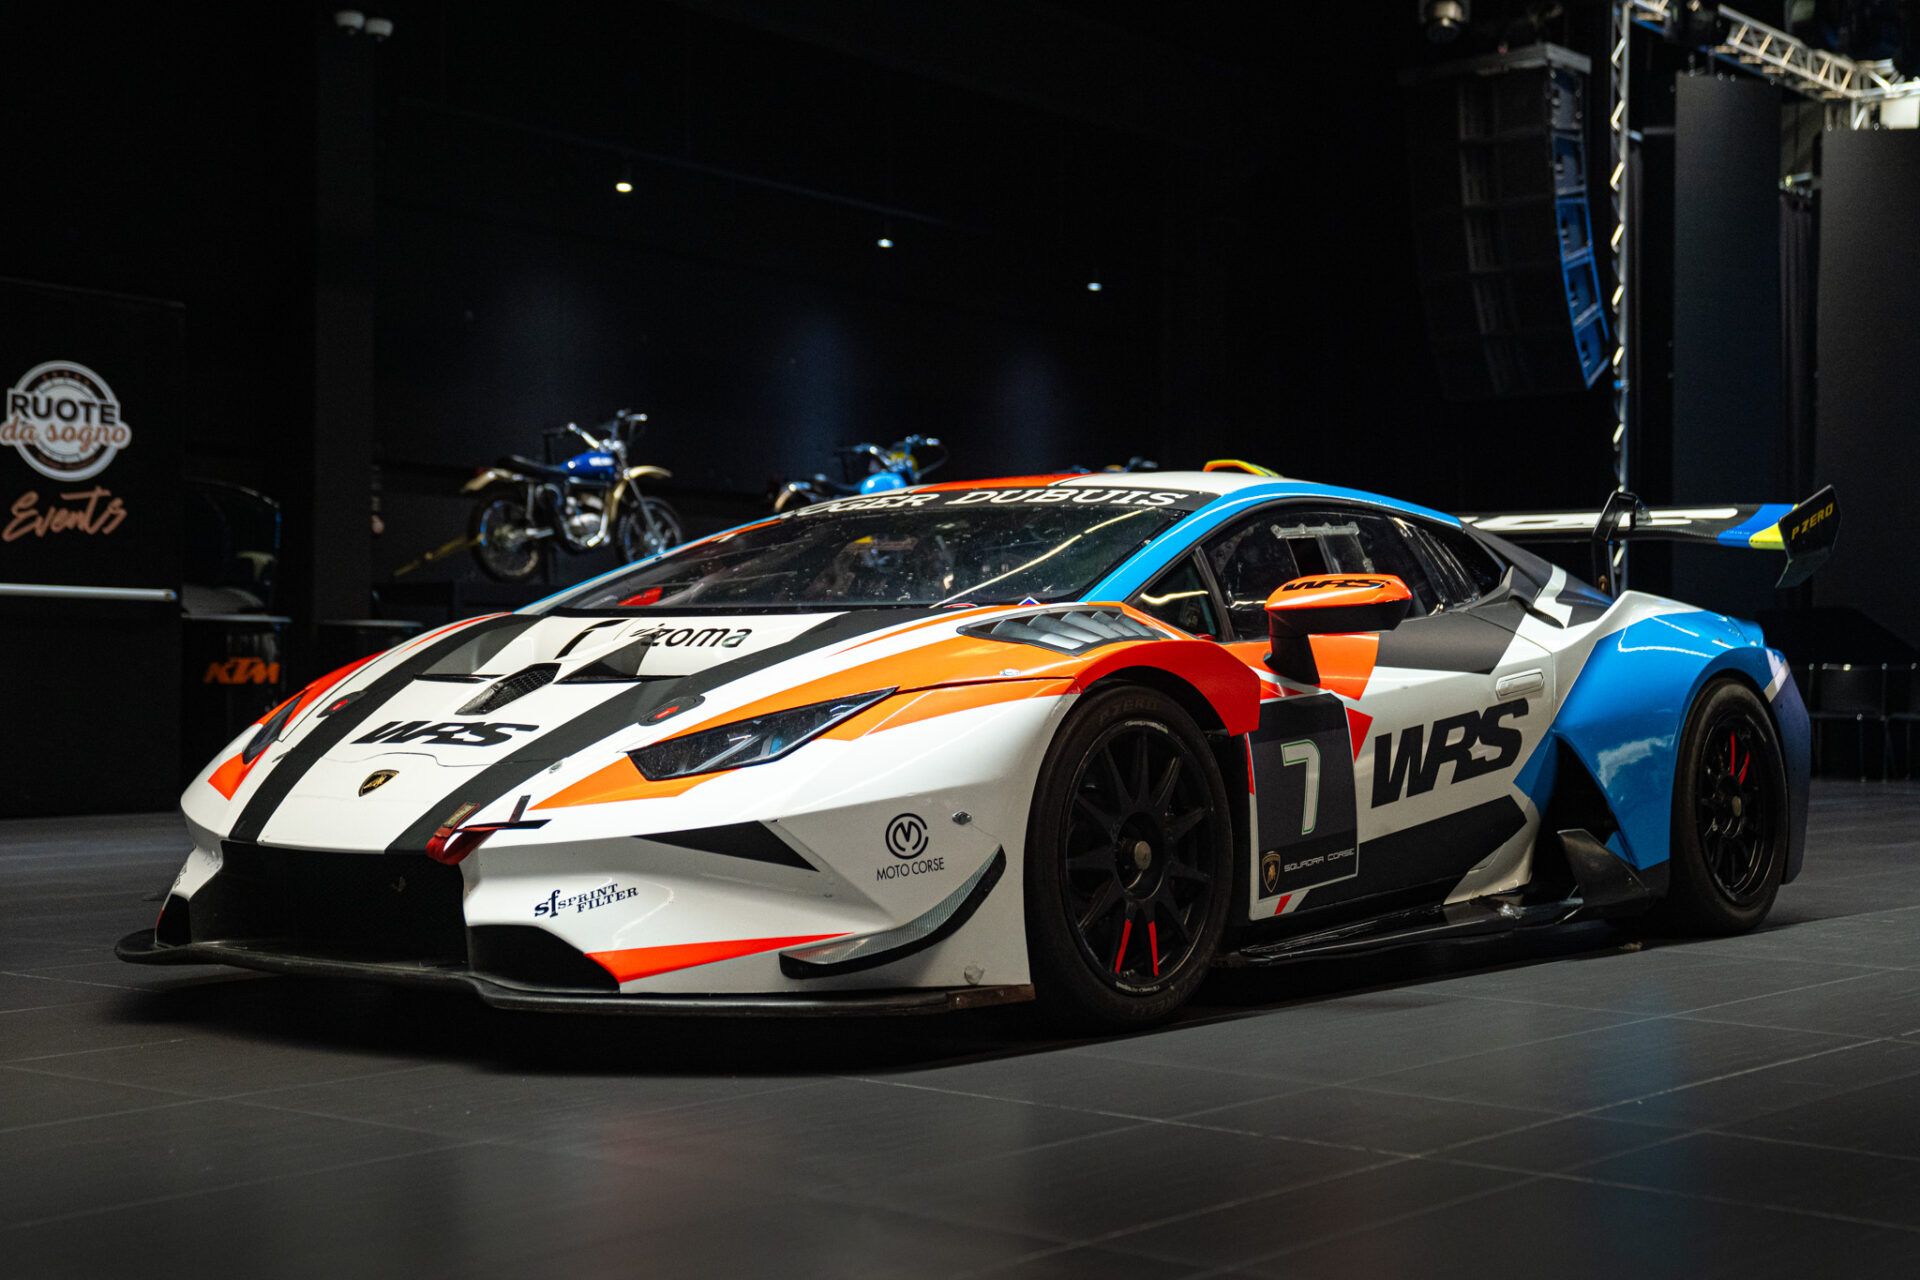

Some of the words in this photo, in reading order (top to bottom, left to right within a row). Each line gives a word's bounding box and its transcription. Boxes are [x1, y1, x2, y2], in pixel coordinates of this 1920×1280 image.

[11, 394, 117, 425] RUOTE
[1, 416, 36, 442] da
[47, 424, 127, 452] sogno
[945, 488, 1191, 507] DUBUIS
[2, 486, 129, 542] Events
[1791, 526, 1800, 541] P
[1801, 502, 1834, 534] ZERO
[1282, 579, 1391, 592] WRS
[203, 656, 281, 684] KTM
[350, 720, 540, 747] WRS
[1371, 698, 1529, 809] WRS
[1281, 739, 1321, 836] 7
[876, 864, 910, 881] MOTO
[912, 857, 945, 875] CORSE
[1284, 856, 1324, 872] SQUADRA
[1327, 848, 1355, 861] CORSE
[558, 883, 618, 909] SPRINT
[577, 887, 639, 913] FILTER
